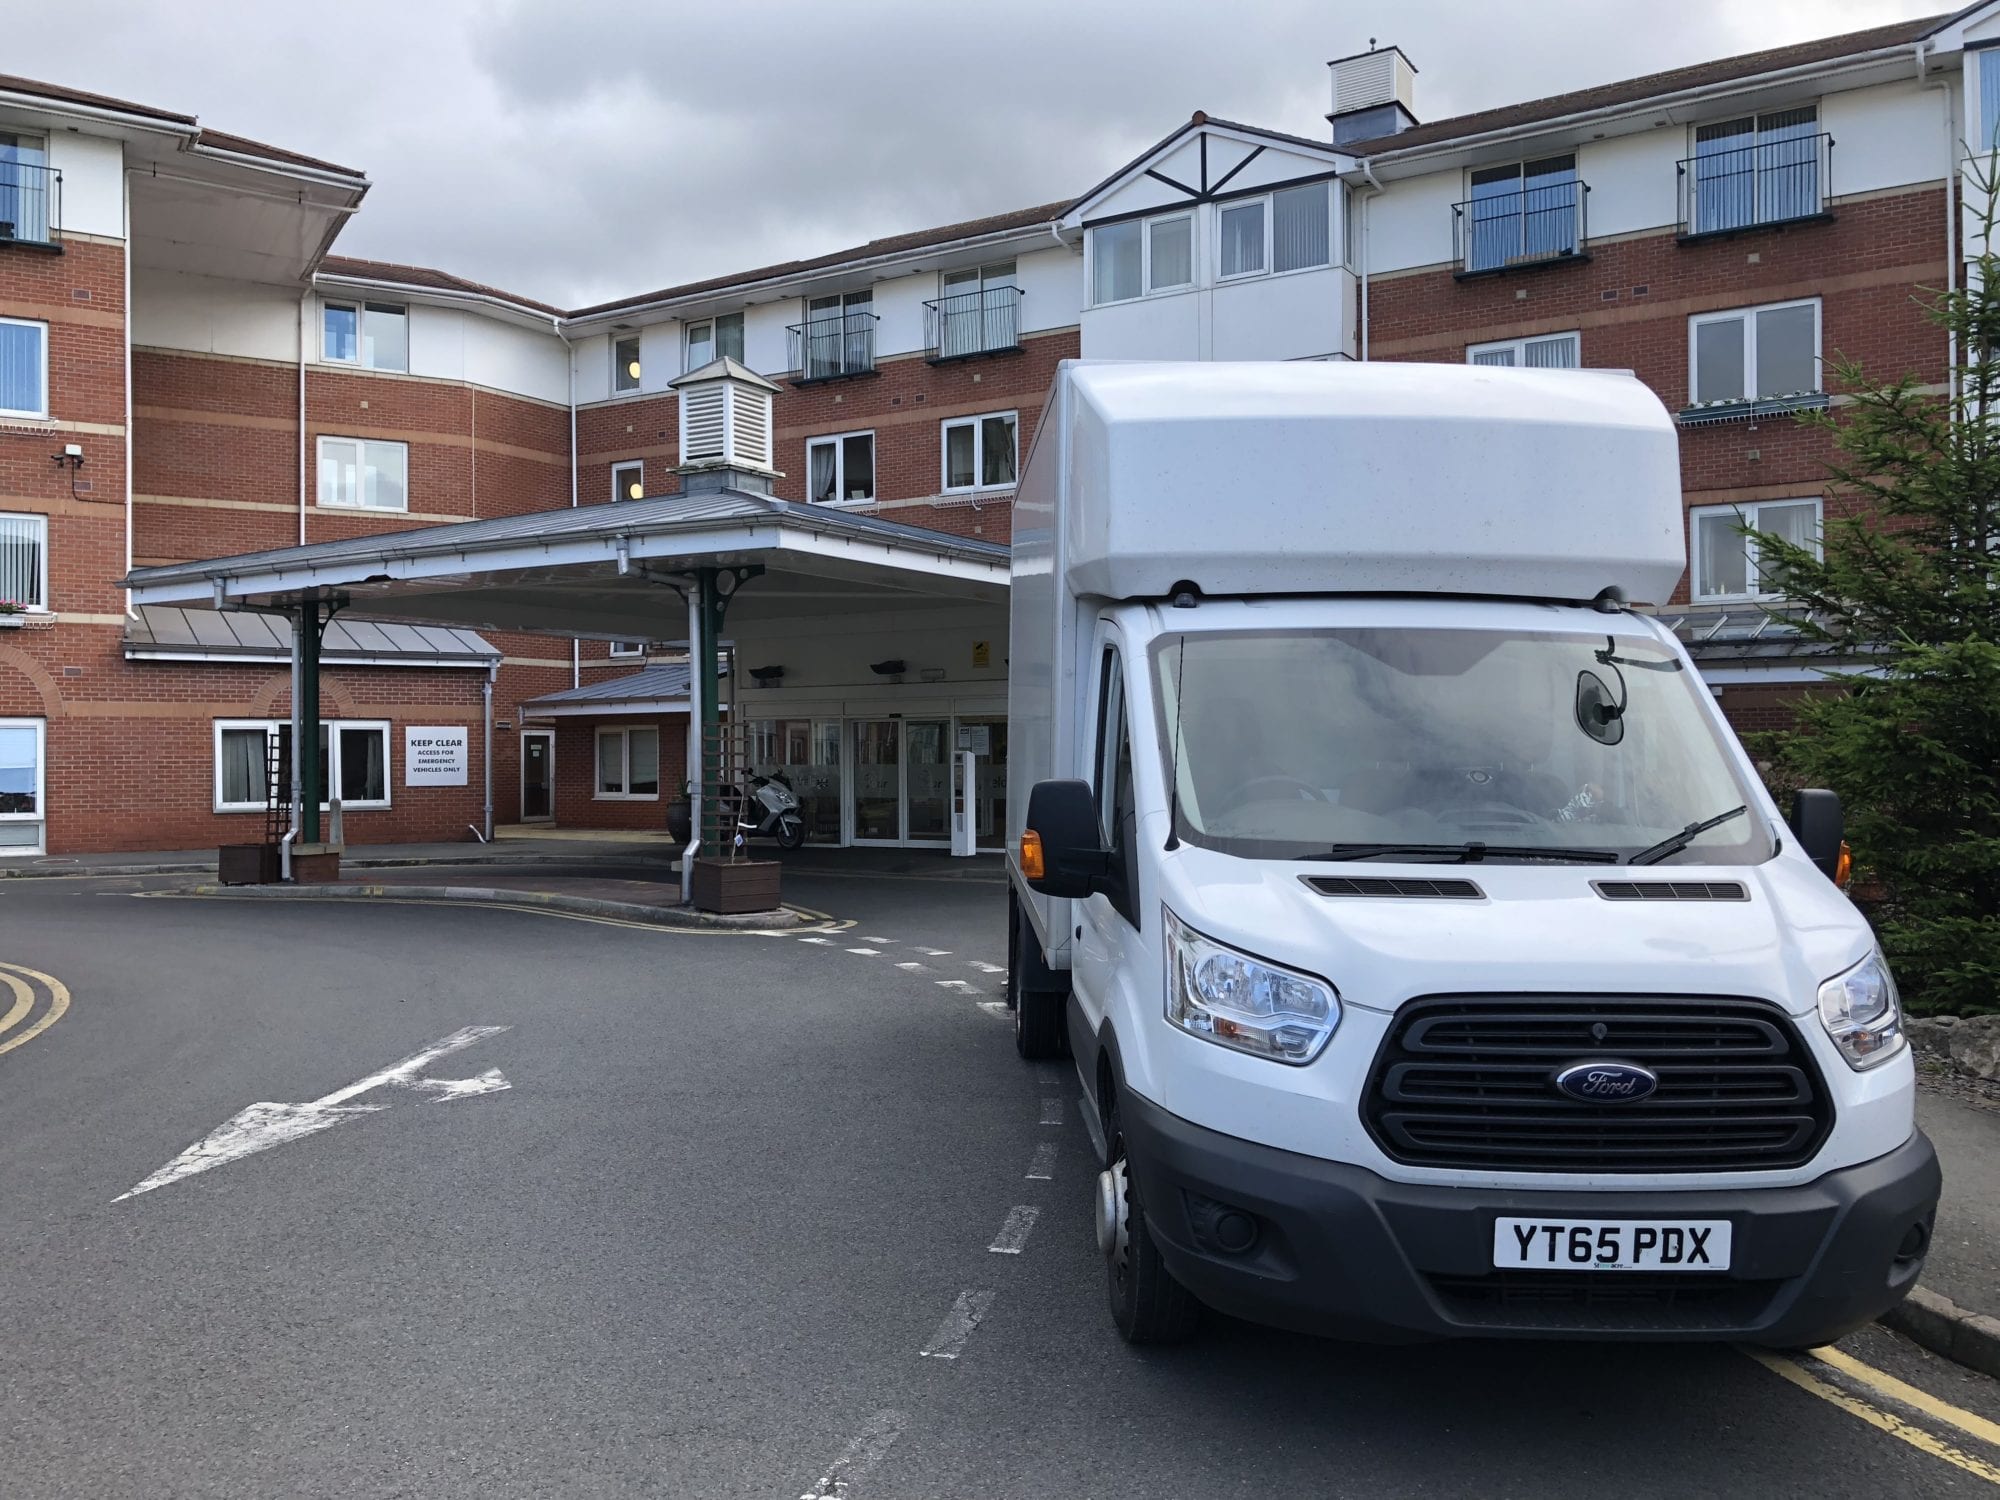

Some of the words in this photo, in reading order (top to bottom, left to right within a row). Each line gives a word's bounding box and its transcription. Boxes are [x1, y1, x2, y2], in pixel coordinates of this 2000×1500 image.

[1582, 1071, 1636, 1095] Ford
[1513, 1225, 1621, 1263] YT65
[1633, 1228, 1712, 1264] PDX
